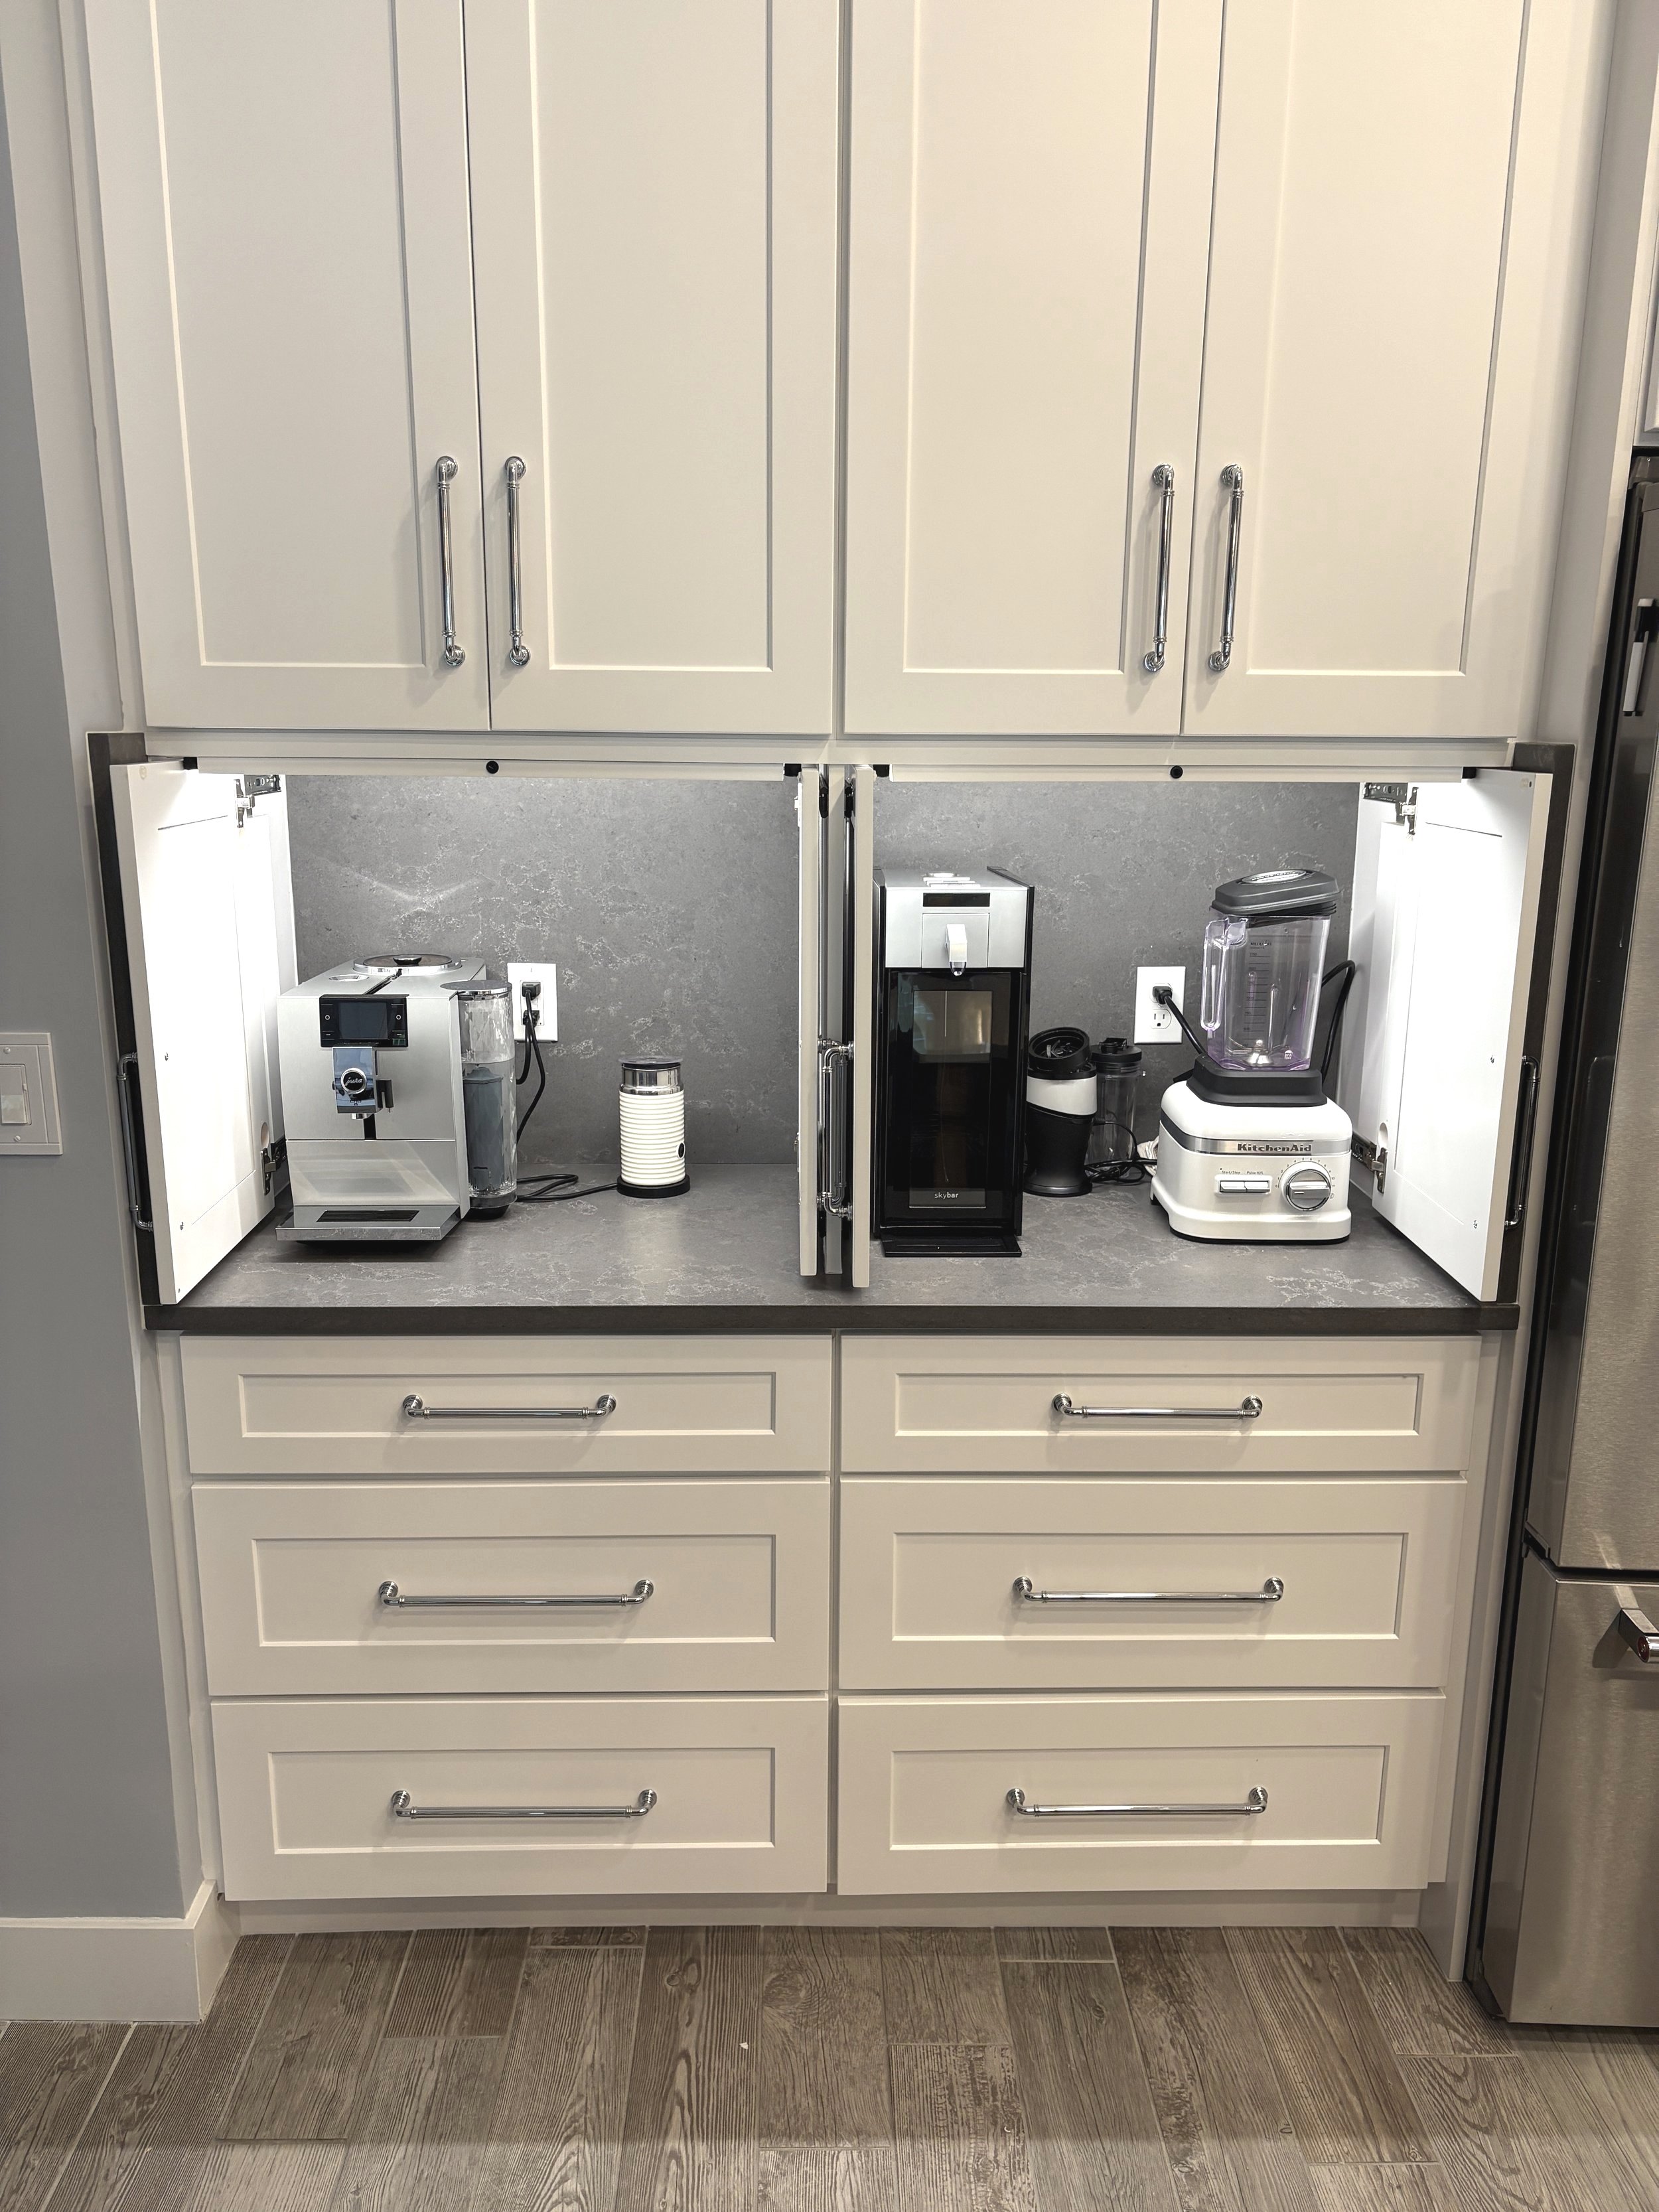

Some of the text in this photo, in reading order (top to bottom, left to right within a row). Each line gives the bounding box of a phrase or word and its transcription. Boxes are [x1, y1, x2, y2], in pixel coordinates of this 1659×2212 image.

[344, 1076, 363, 1086] jura
[1237, 1143, 1312, 1152] KitchenAid
[934, 1191, 959, 1200] skybar
